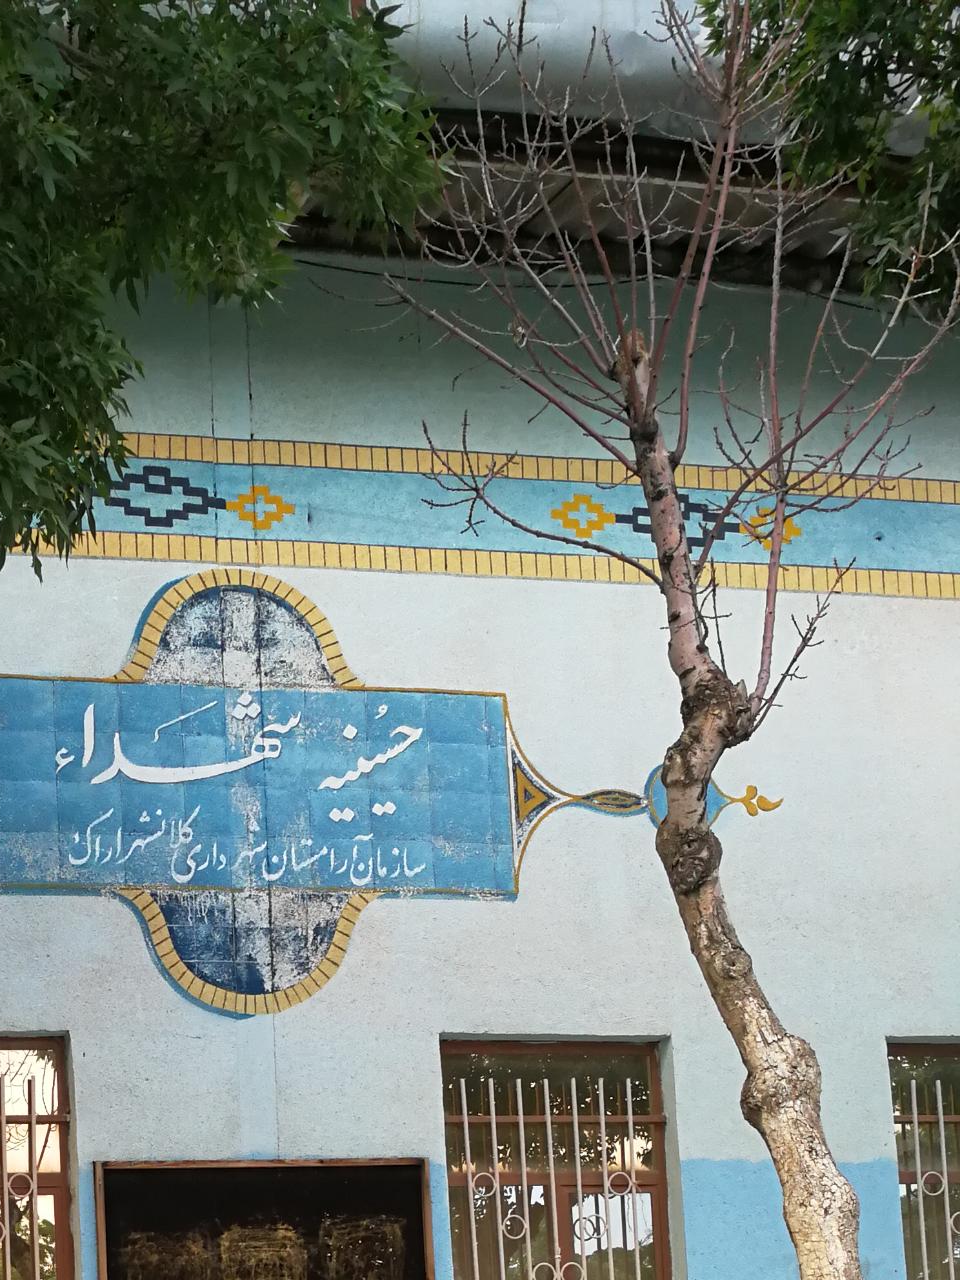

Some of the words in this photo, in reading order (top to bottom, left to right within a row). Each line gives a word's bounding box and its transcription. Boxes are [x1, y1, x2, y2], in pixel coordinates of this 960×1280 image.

[68, 807, 123, 866] اراک
[116, 804, 201, 865] کلانشهر
[262, 832, 375, 882] آرامستان
[349, 847, 426, 887] سازمان
